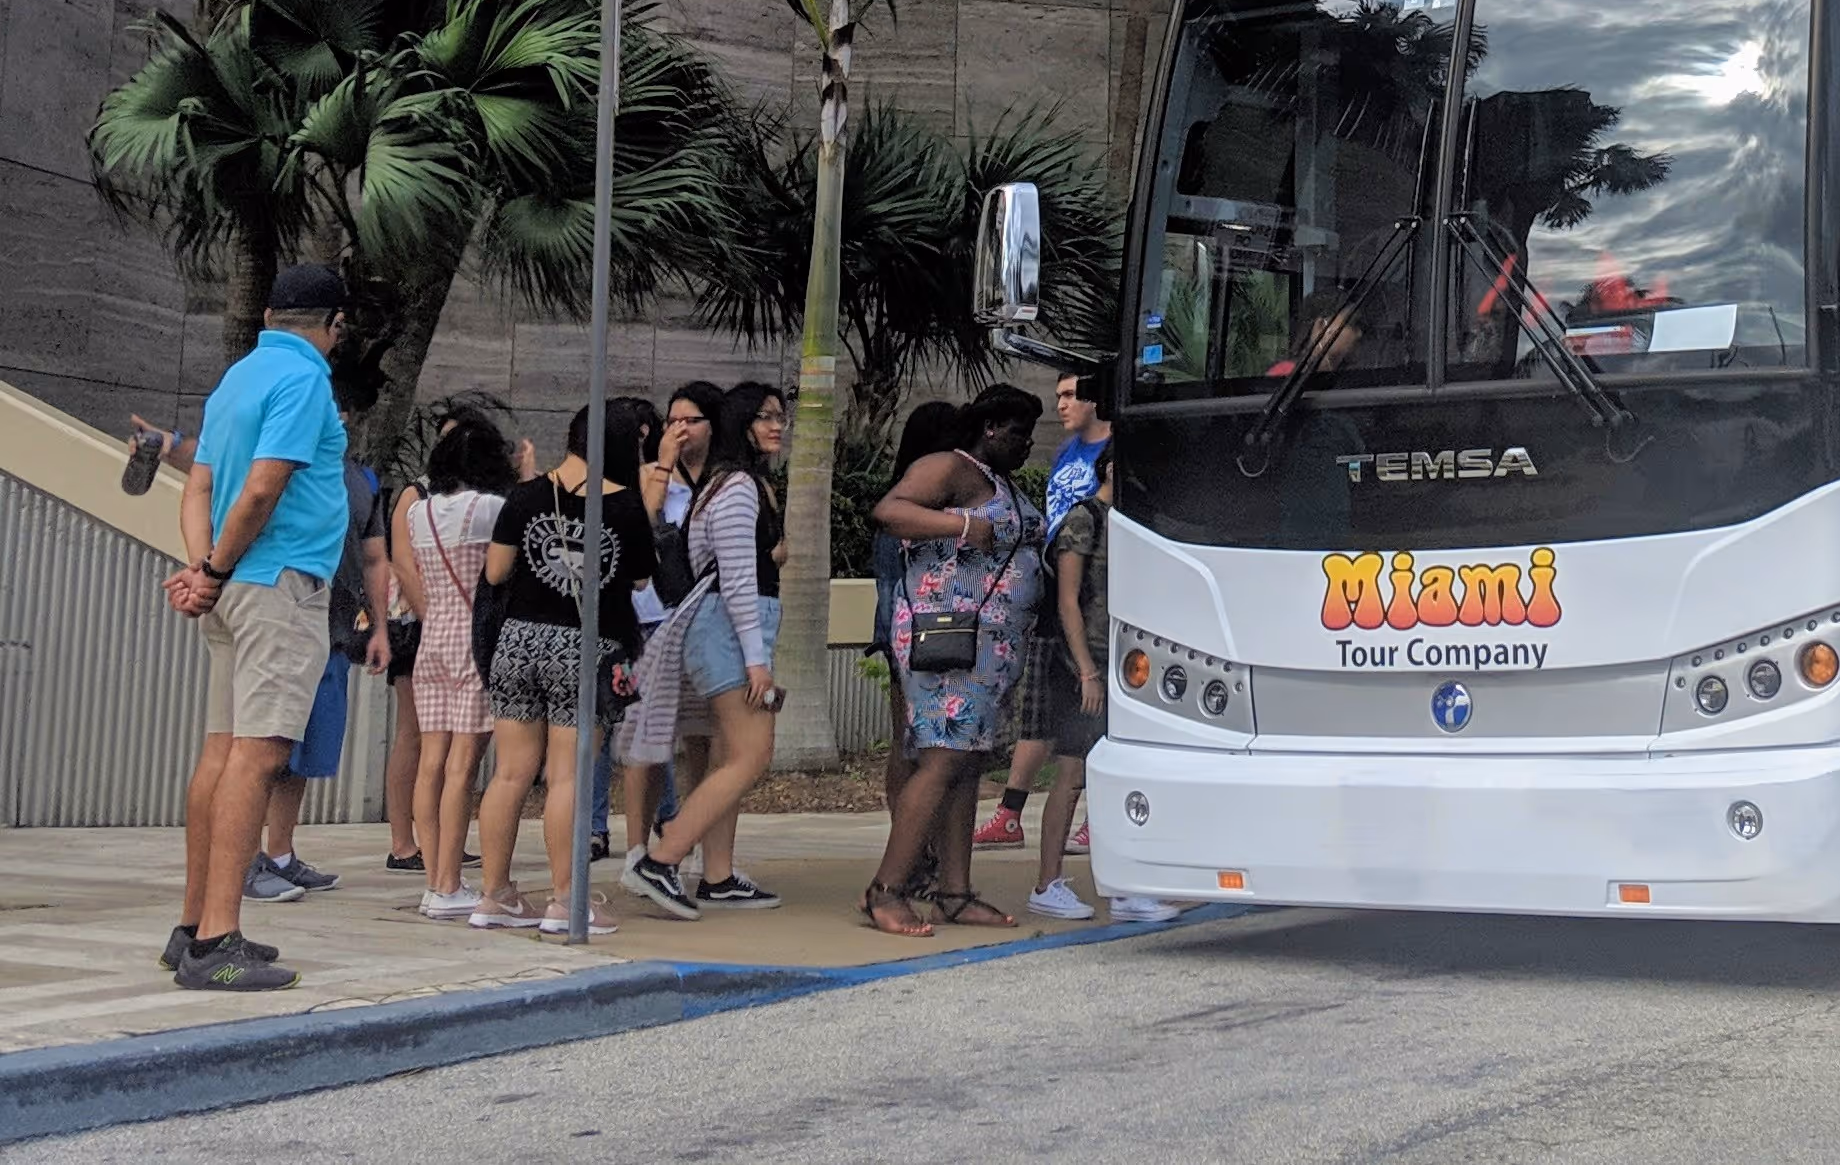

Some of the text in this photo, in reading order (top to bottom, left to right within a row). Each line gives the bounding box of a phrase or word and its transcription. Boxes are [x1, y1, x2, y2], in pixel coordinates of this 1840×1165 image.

[1335, 446, 1539, 483] TEMSA
[1321, 546, 1562, 631] Miami
[1335, 638, 1549, 671] Tour Company
